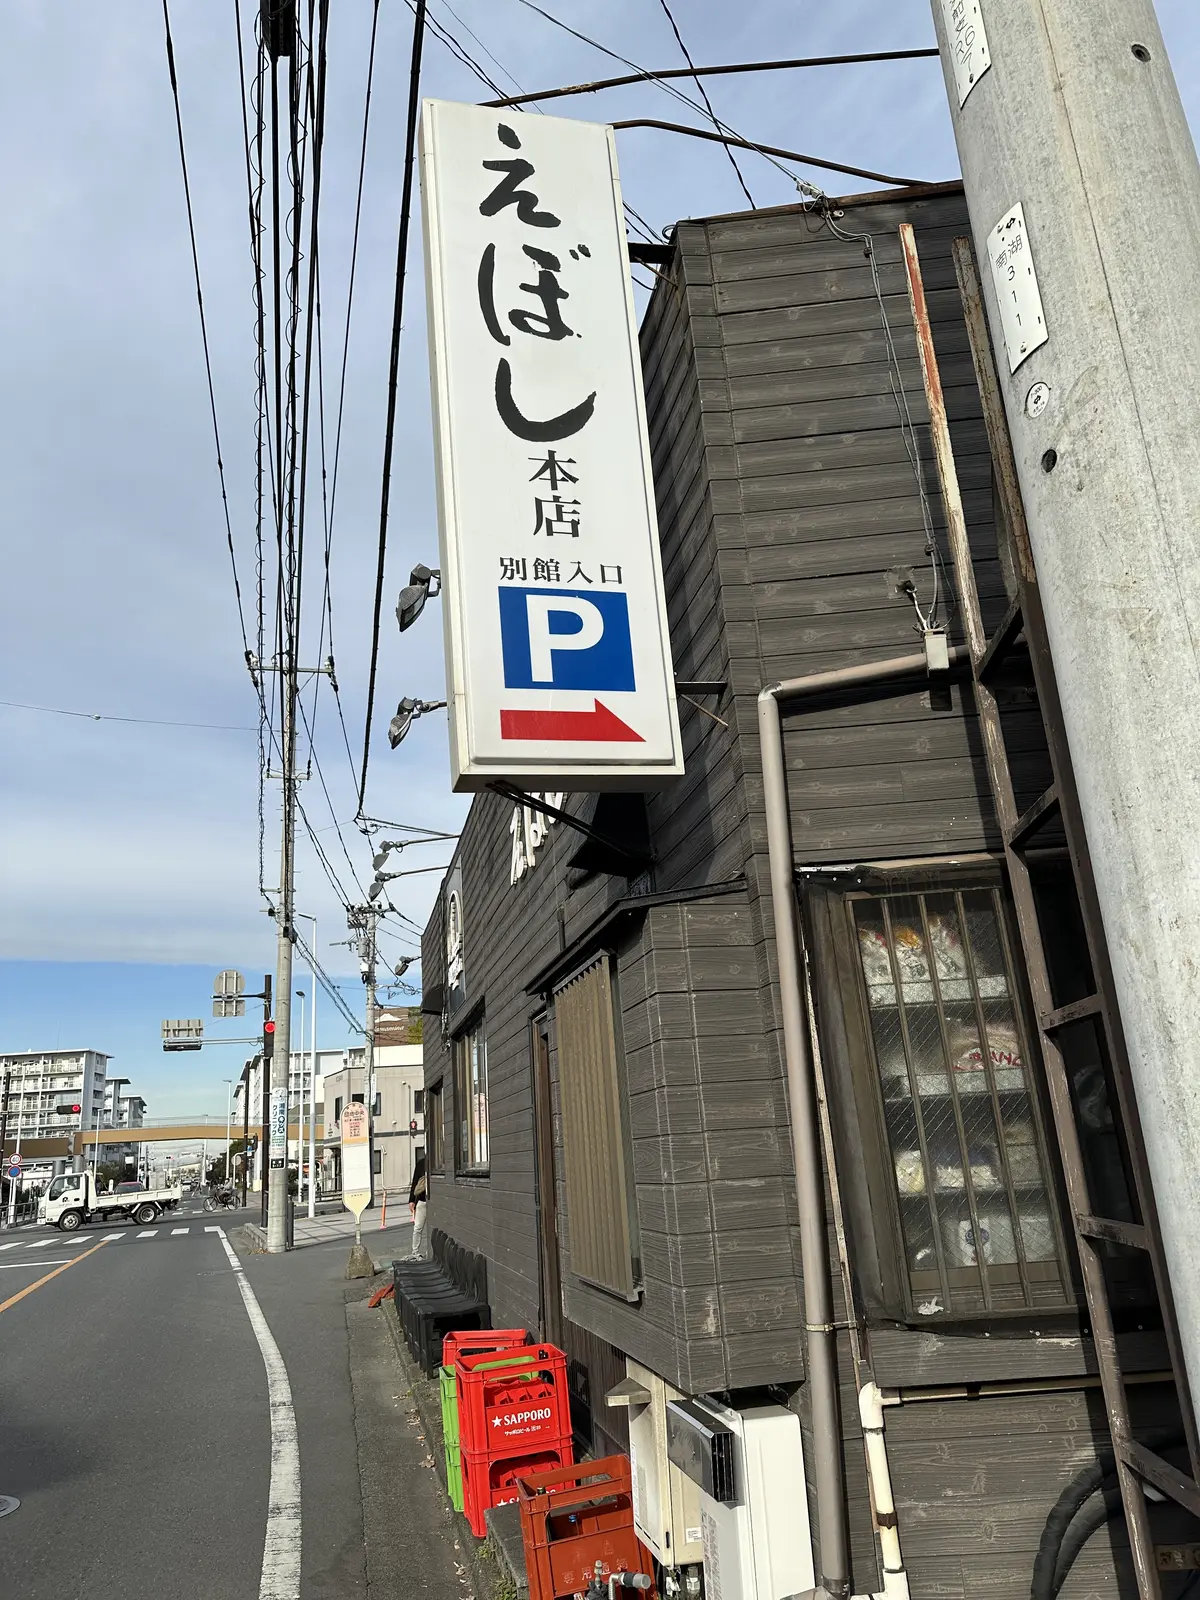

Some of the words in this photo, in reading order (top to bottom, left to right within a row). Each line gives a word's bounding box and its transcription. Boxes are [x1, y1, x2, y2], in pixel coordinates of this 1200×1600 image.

[478, 123, 596, 442] えぼし
[528, 450, 581, 538] 本店
[500, 557, 623, 586] 別館入口
[525, 594, 604, 684] P
[504, 1408, 551, 1427] SAPPORO
